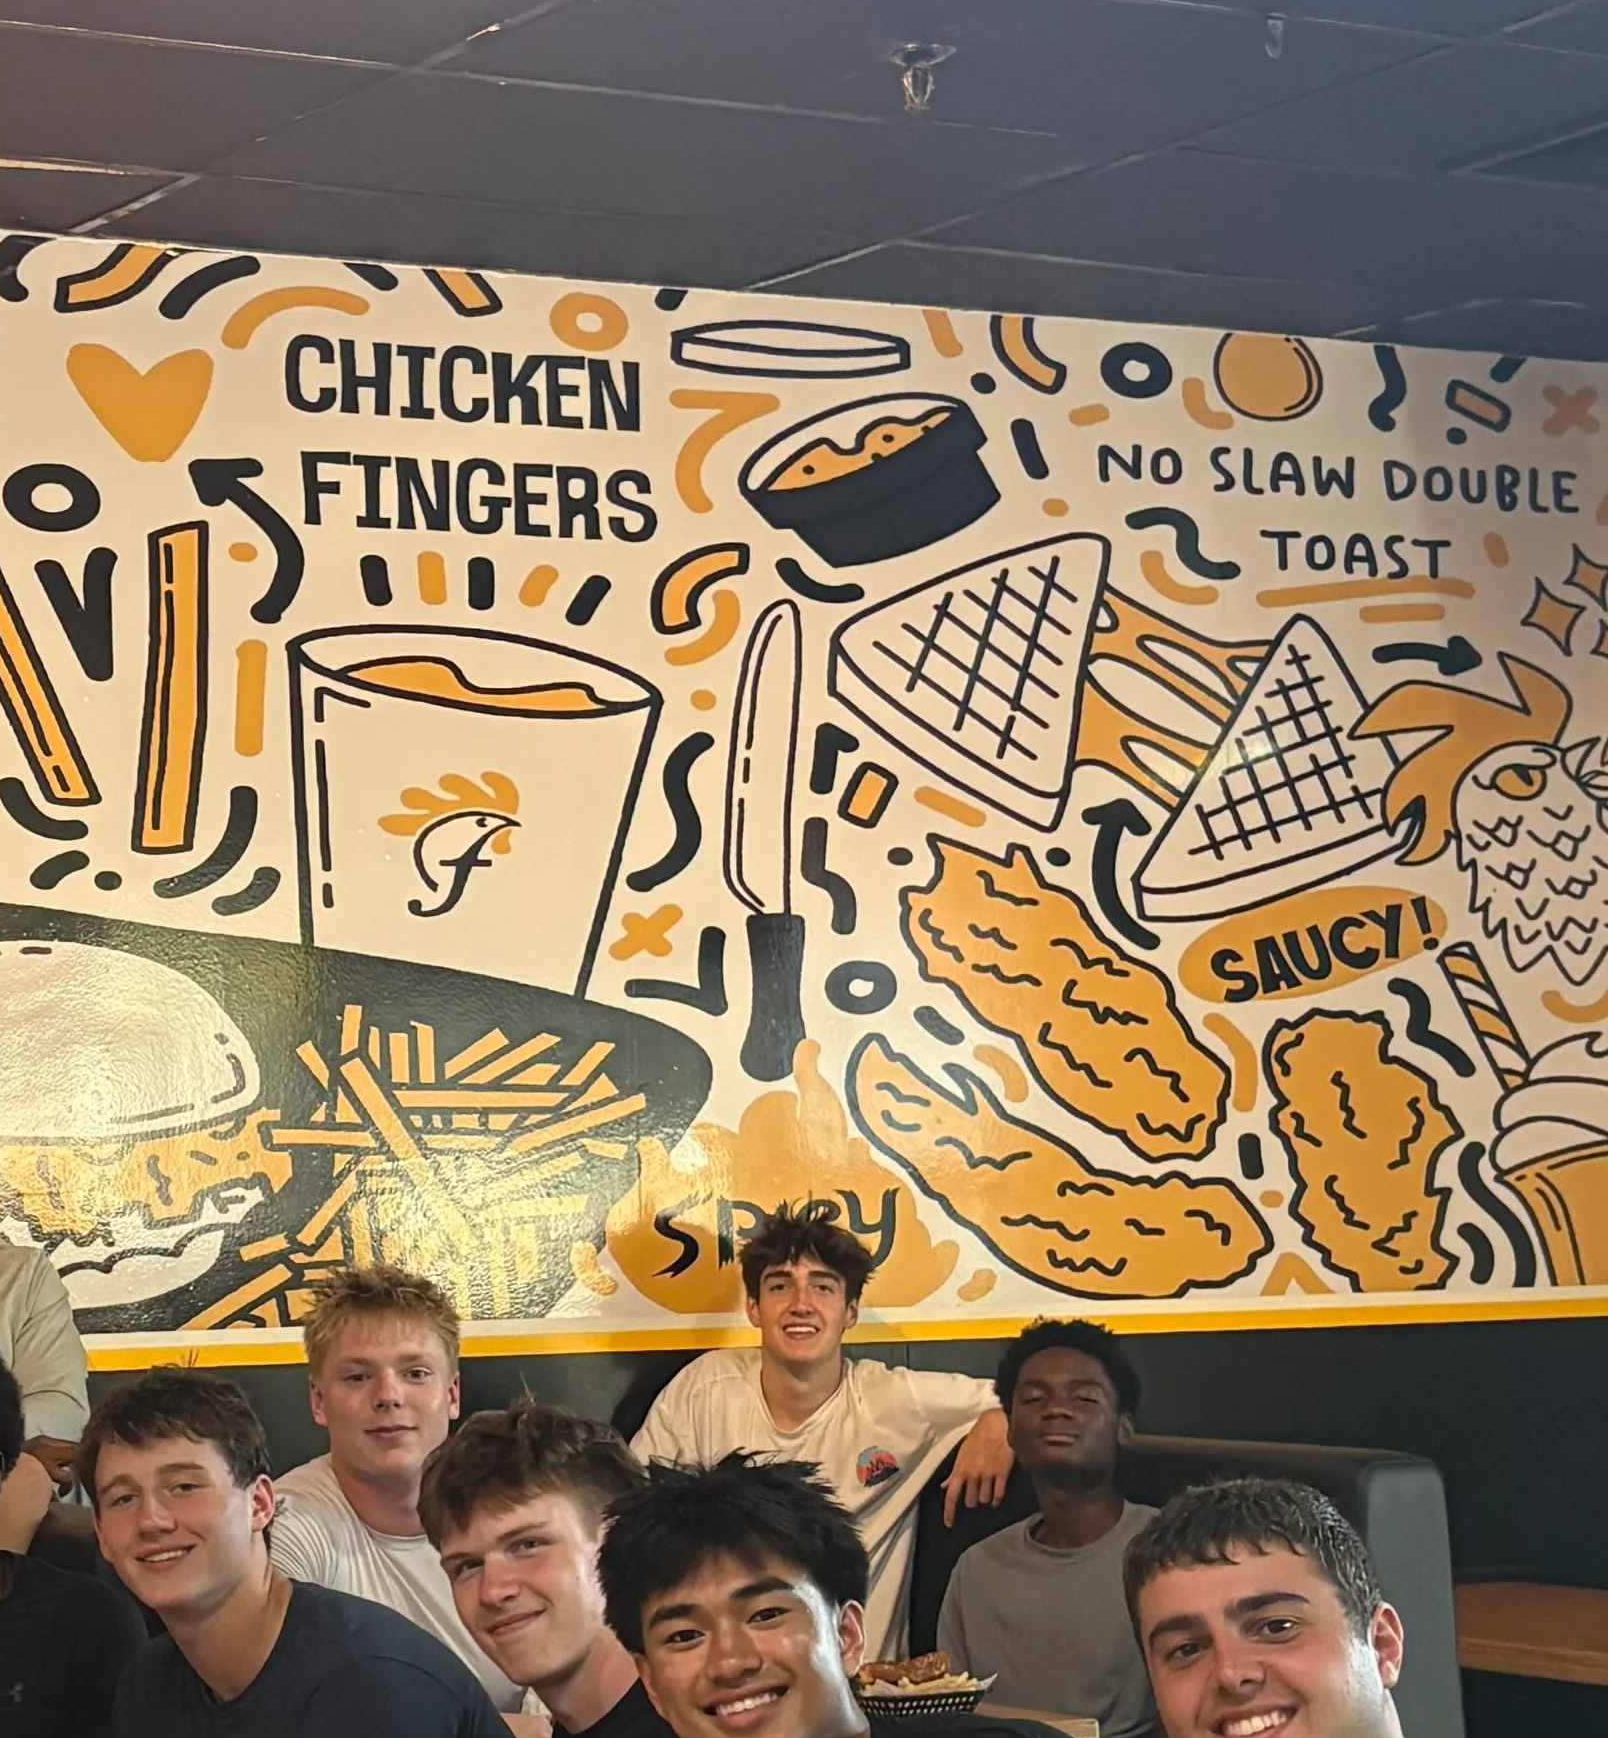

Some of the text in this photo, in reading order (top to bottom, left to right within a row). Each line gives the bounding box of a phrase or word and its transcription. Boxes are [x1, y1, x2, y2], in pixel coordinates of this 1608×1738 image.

[284, 333, 641, 432] CHICKEN
[300, 450, 658, 543] FINGERS
[1098, 444, 1580, 513] NO SLAW DOUBLE
[1260, 529, 1452, 580] TOAST
[1210, 895, 1440, 1004] SAUCY!
